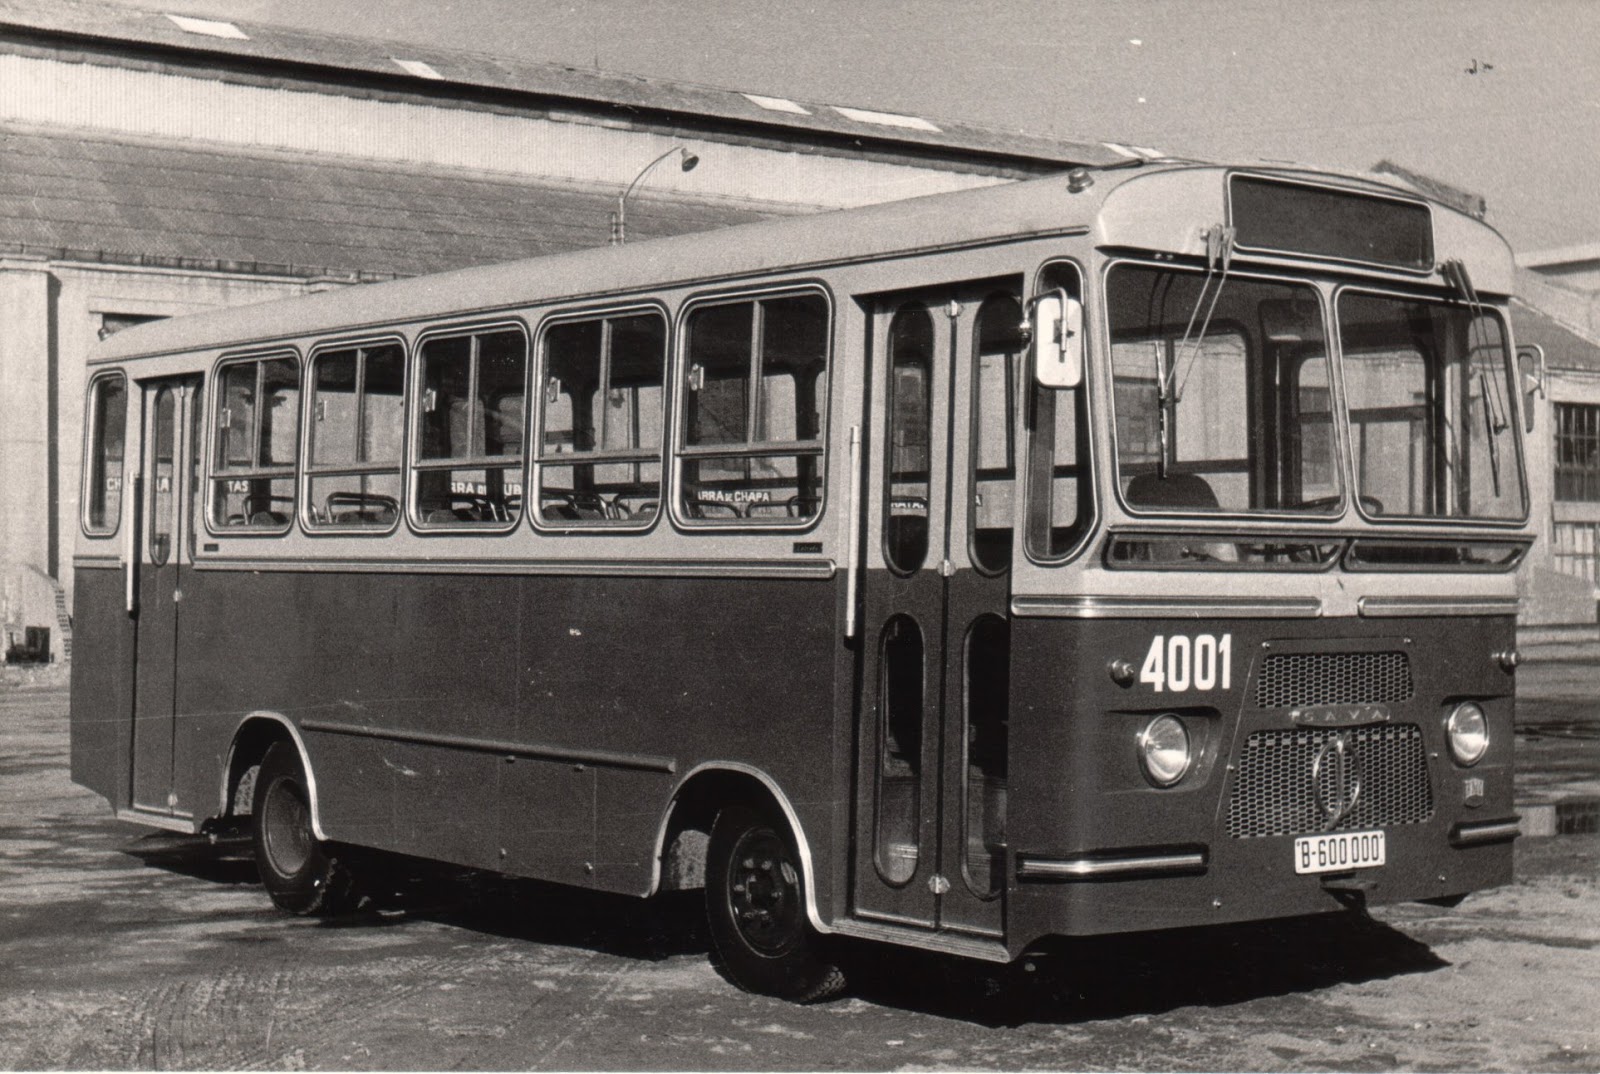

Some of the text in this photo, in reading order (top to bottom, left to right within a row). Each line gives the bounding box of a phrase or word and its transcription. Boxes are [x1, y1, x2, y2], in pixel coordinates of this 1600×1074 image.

[734, 490, 770, 502] CHAPA
[1140, 634, 1231, 692] 4001
[1304, 710, 1384, 721] SAVA
